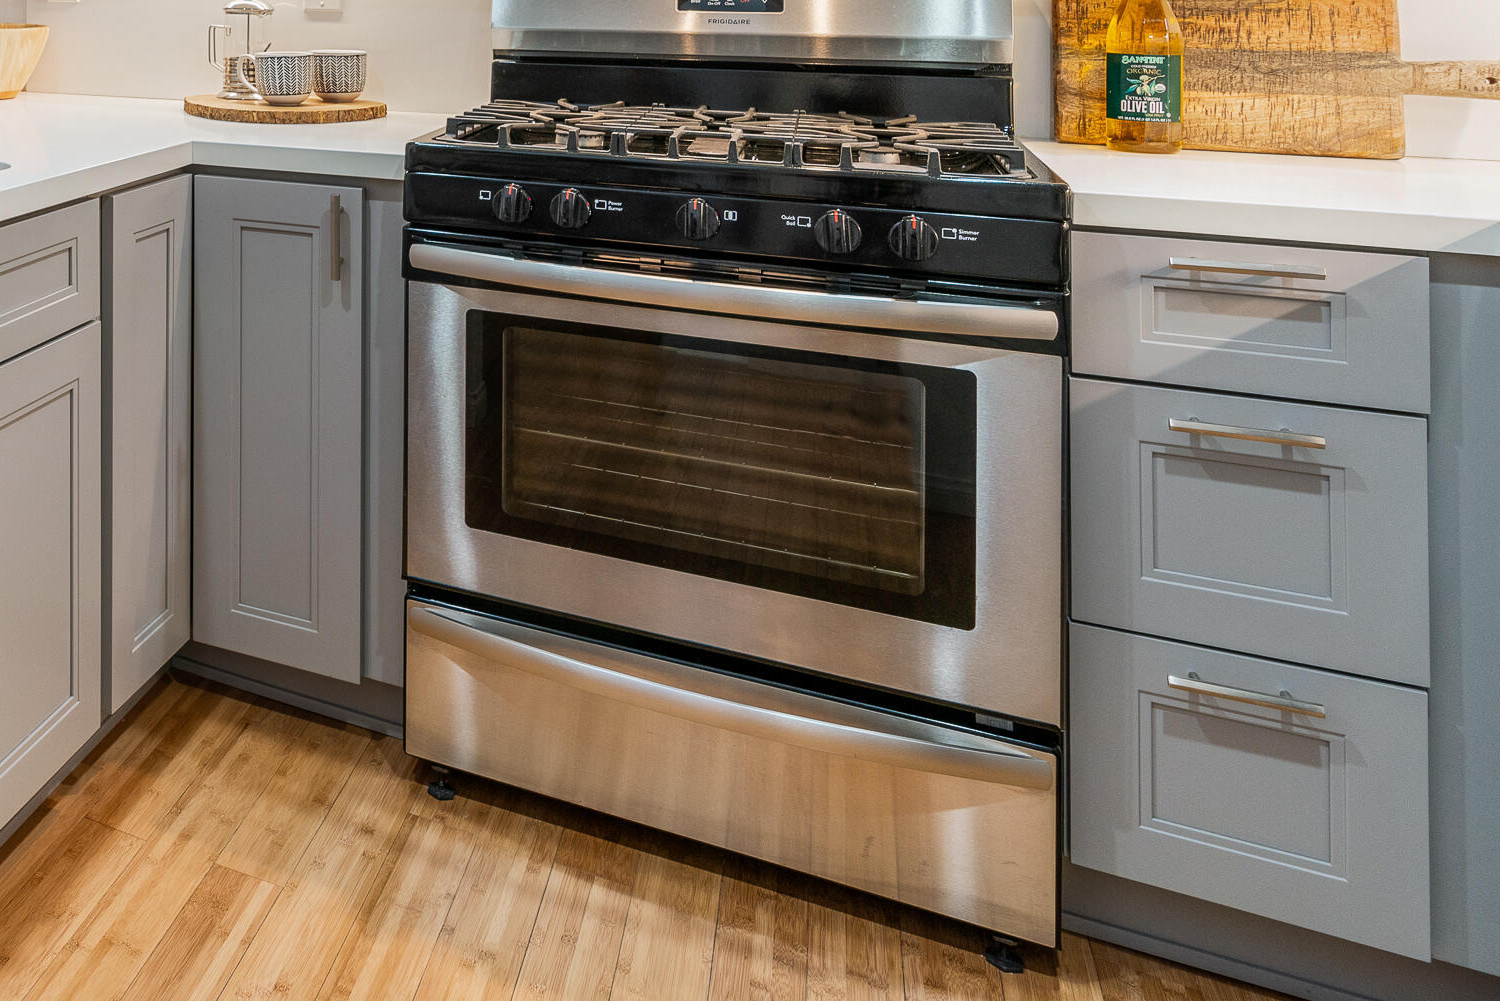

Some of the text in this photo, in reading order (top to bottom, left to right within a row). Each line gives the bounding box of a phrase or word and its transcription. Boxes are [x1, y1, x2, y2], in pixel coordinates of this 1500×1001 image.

[1121, 55, 1165, 64] SANTINI
[1120, 100, 1165, 114] OLIVE OIL
